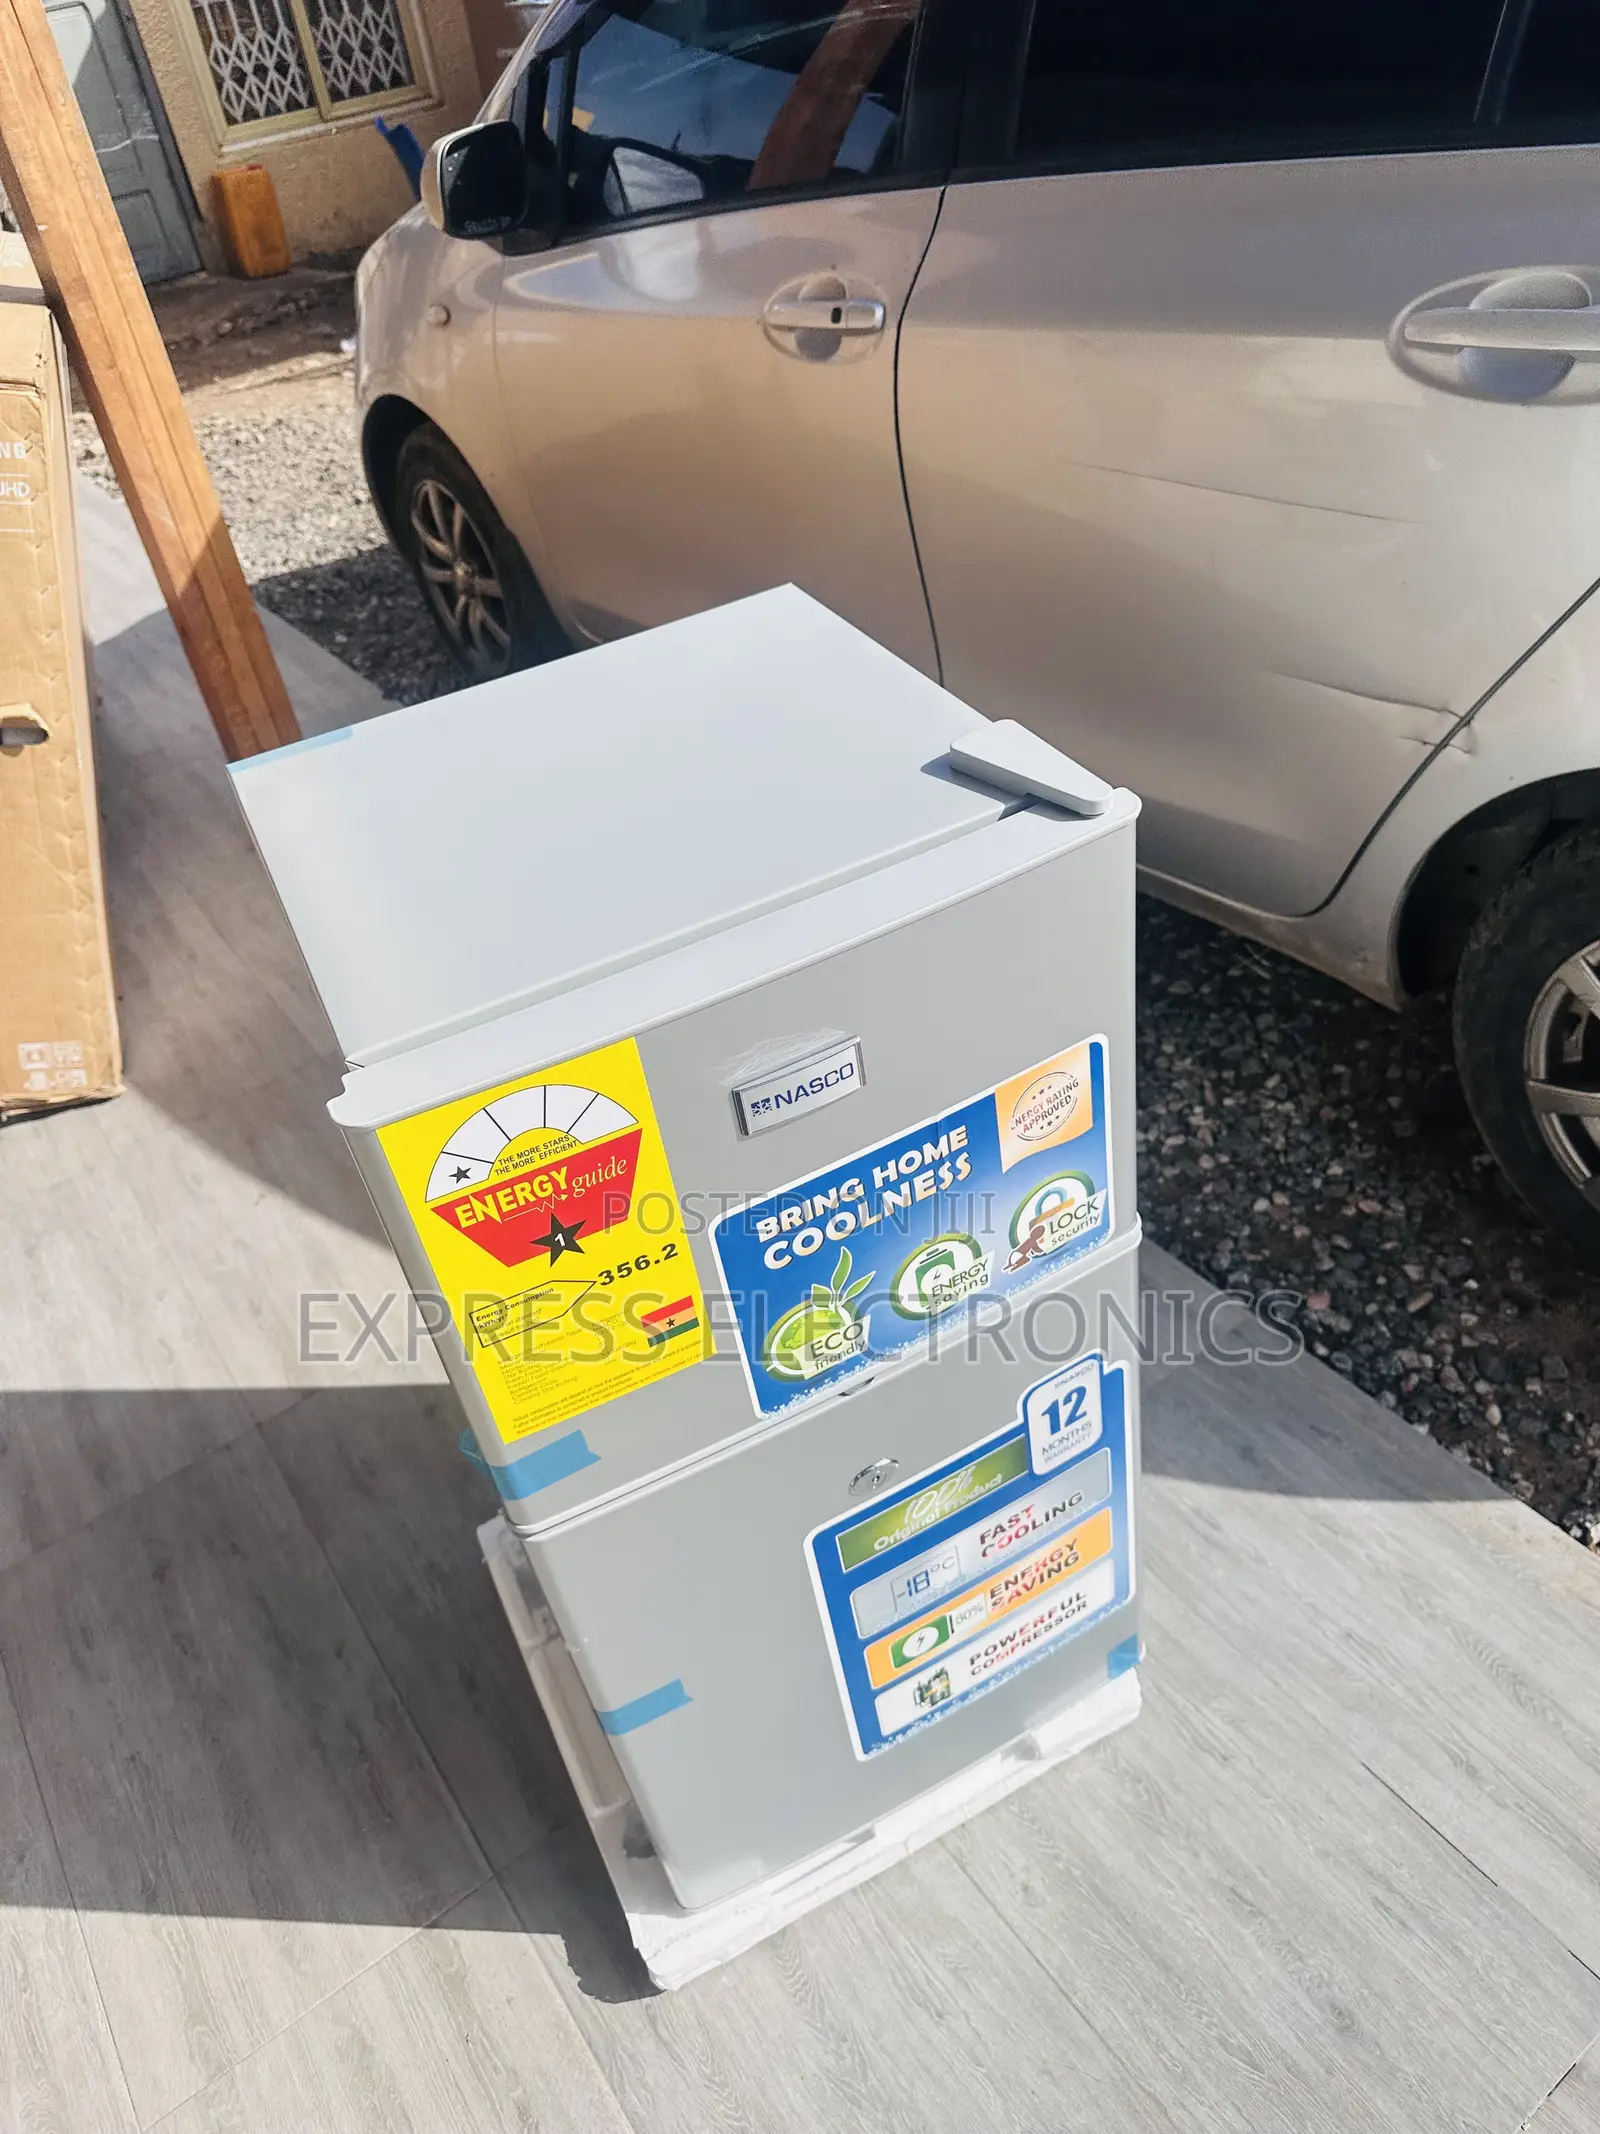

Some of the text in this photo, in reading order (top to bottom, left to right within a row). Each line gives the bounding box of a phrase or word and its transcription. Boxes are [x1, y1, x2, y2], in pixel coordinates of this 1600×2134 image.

[774, 1062, 854, 1109] NASCO
[1010, 1078, 1080, 1131] ENERGY RATING
[1023, 1094, 1072, 1133] APPROVED
[494, 1140, 579, 1176] THE MORE EFFICIENT
[499, 1134, 570, 1166] THE MORE STARS
[454, 1155, 628, 1229] ENERGY guide
[756, 1124, 969, 1244] BRING HOME
[763, 1151, 973, 1271] COOLNESS
[1050, 1196, 1099, 1236] LOCK
[1051, 1212, 1101, 1247] security
[554, 1232, 567, 1247] 1
[597, 1243, 679, 1286] 356.2
[932, 1257, 989, 1298] ENERGY
[475, 1286, 554, 1322] Energy Consumption
[935, 1273, 989, 1308] saving
[810, 1322, 863, 1360] ECO
[814, 1339, 866, 1371] friendly
[1041, 1385, 1087, 1436] 12
[1041, 1420, 1092, 1456] MONTHS
[873, 1472, 1003, 1552] Original Product
[979, 1503, 1035, 1545] FAST
[981, 1491, 1084, 1558] COOLING
[989, 1538, 1078, 1599] ENERGY
[991, 1551, 1080, 1610] SAVING
[969, 1590, 1087, 1667] POWERFUL
[970, 1601, 1088, 1676] COMPRESSOR
